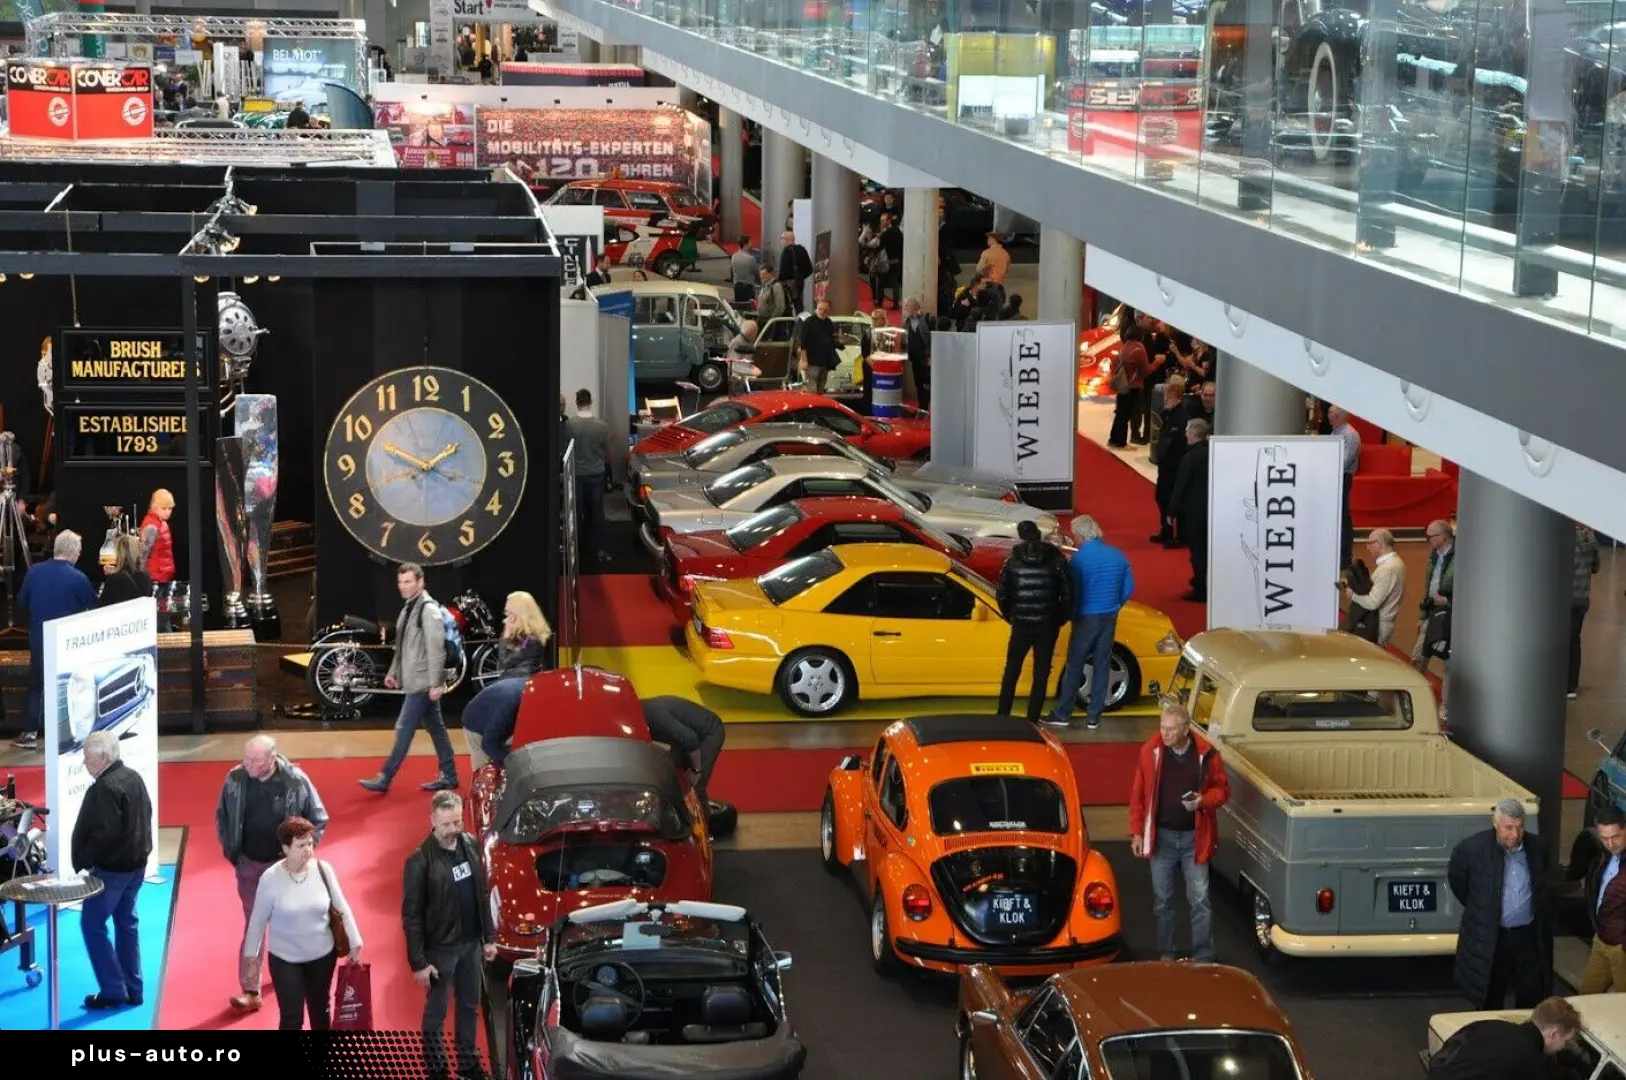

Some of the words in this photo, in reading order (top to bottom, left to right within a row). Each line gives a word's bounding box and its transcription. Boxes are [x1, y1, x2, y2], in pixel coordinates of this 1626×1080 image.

[453, 0, 484, 15] Start
[9, 66, 71, 85] COVERCAR
[77, 68, 149, 87] COVERCAR
[487, 120, 514, 134] DIE
[487, 138, 674, 156] MOBILITÄTS-EXPERTEN
[535, 157, 599, 177] 120
[110, 340, 162, 358] BRUSH
[376, 384, 397, 412] 11
[412, 375, 440, 402] 12
[461, 385, 471, 413] 1
[1017, 341, 1041, 462] WIEBE
[343, 414, 373, 443] 10
[487, 413, 506, 439] 2
[116, 436, 159, 453] 1793
[337, 454, 356, 481] 9
[497, 451, 515, 478] 3
[348, 492, 366, 520] 8
[484, 488, 503, 516] 4
[379, 521, 396, 548] 7
[417, 530, 437, 558] 6
[458, 520, 476, 547] 5
[1264, 463, 1297, 618] WIEBE
[65, 630, 105, 651] TRAUM
[107, 618, 150, 640] PAGODE
[1023, 897, 1031, 909] &
[1393, 884, 1421, 896] KIEFT
[1422, 884, 1430, 896] &
[1399, 898, 1425, 910] KLOK
[1000, 912, 1025, 924] KLOK
